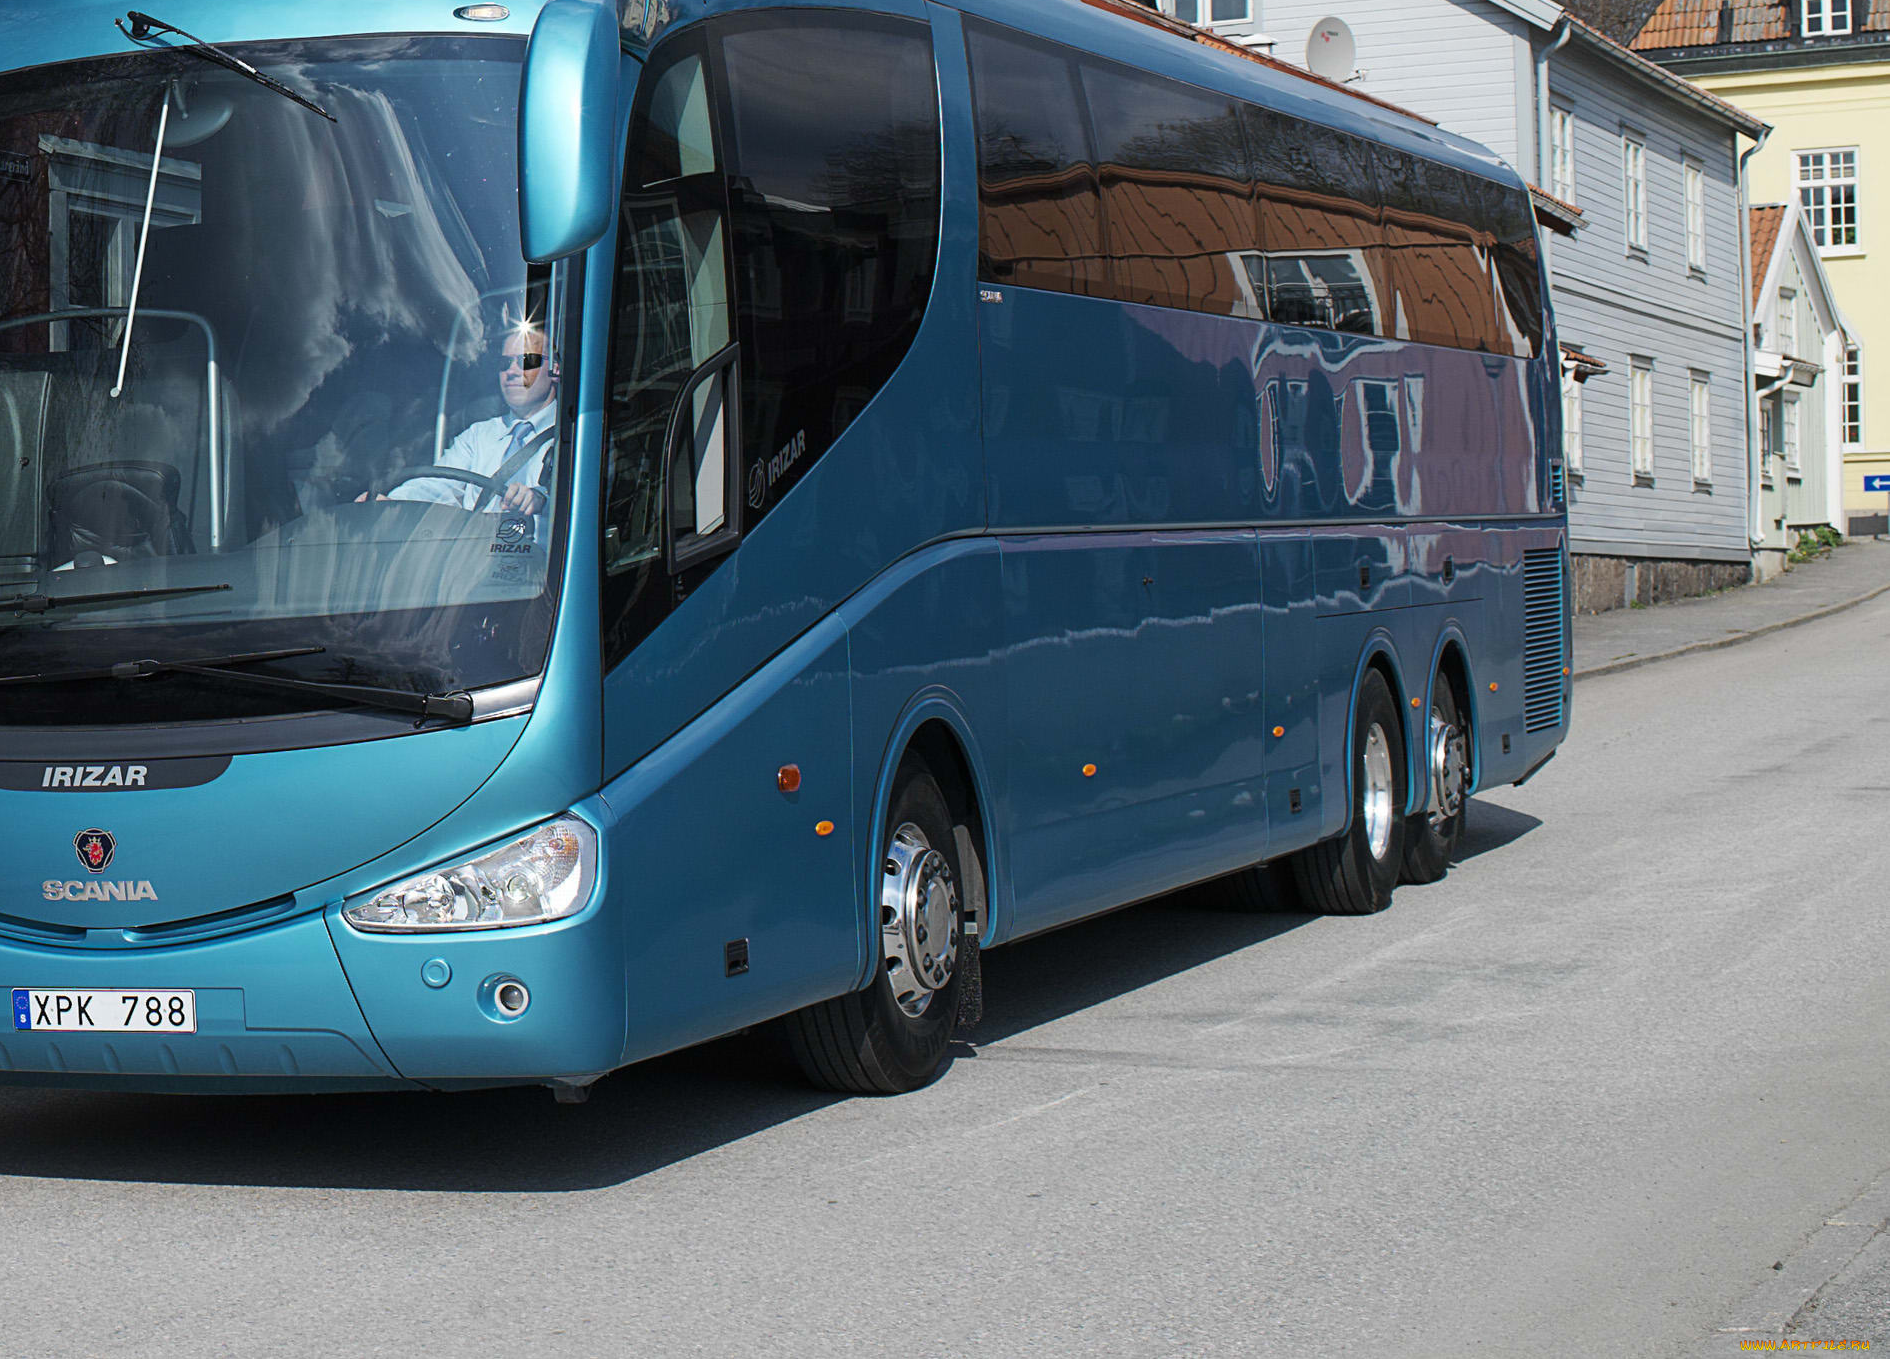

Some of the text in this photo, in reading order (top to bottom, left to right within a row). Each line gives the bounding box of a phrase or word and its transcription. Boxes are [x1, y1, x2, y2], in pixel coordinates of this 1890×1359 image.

[768, 428, 806, 487] IRIZAR
[490, 544, 532, 553] IRIZAR
[42, 766, 148, 787] IRIZAR
[42, 880, 159, 901] SCANIA
[20, 1014, 27, 1023] S
[35, 995, 186, 1027] XPK 788
